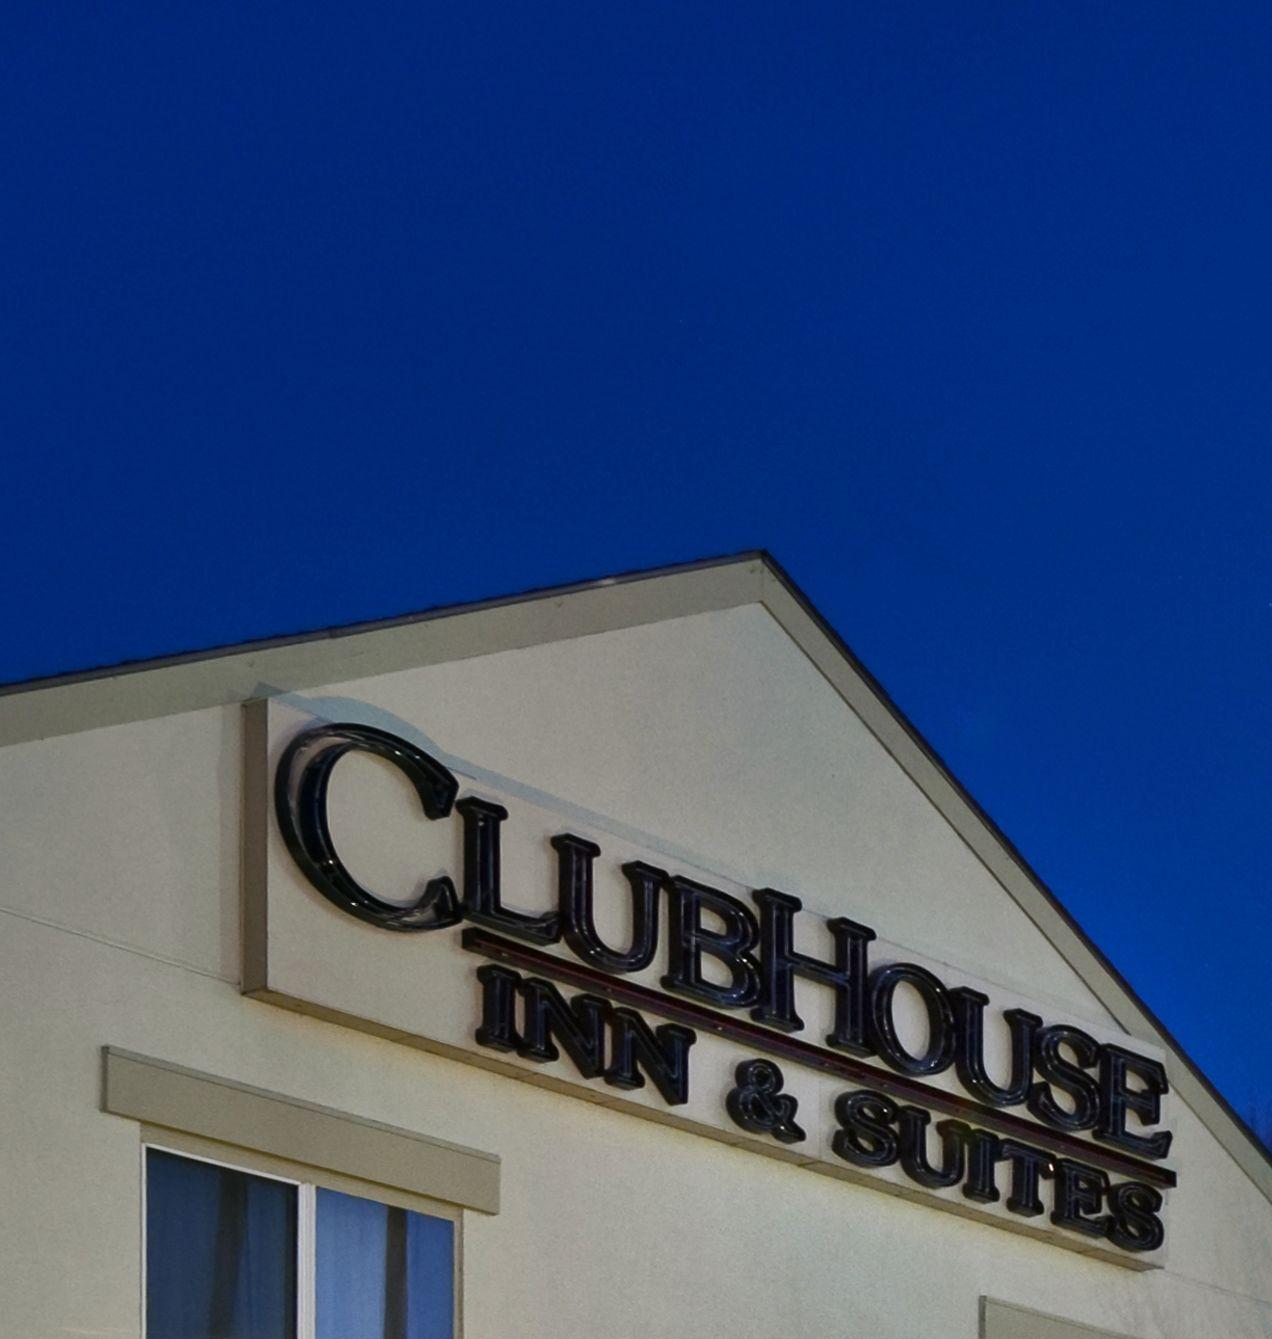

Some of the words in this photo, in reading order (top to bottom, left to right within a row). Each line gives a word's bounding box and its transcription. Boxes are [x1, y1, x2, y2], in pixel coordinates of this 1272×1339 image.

[476, 965, 695, 1105] INN
[726, 1059, 806, 1143] &
[833, 1090, 1164, 1251] SUITES
